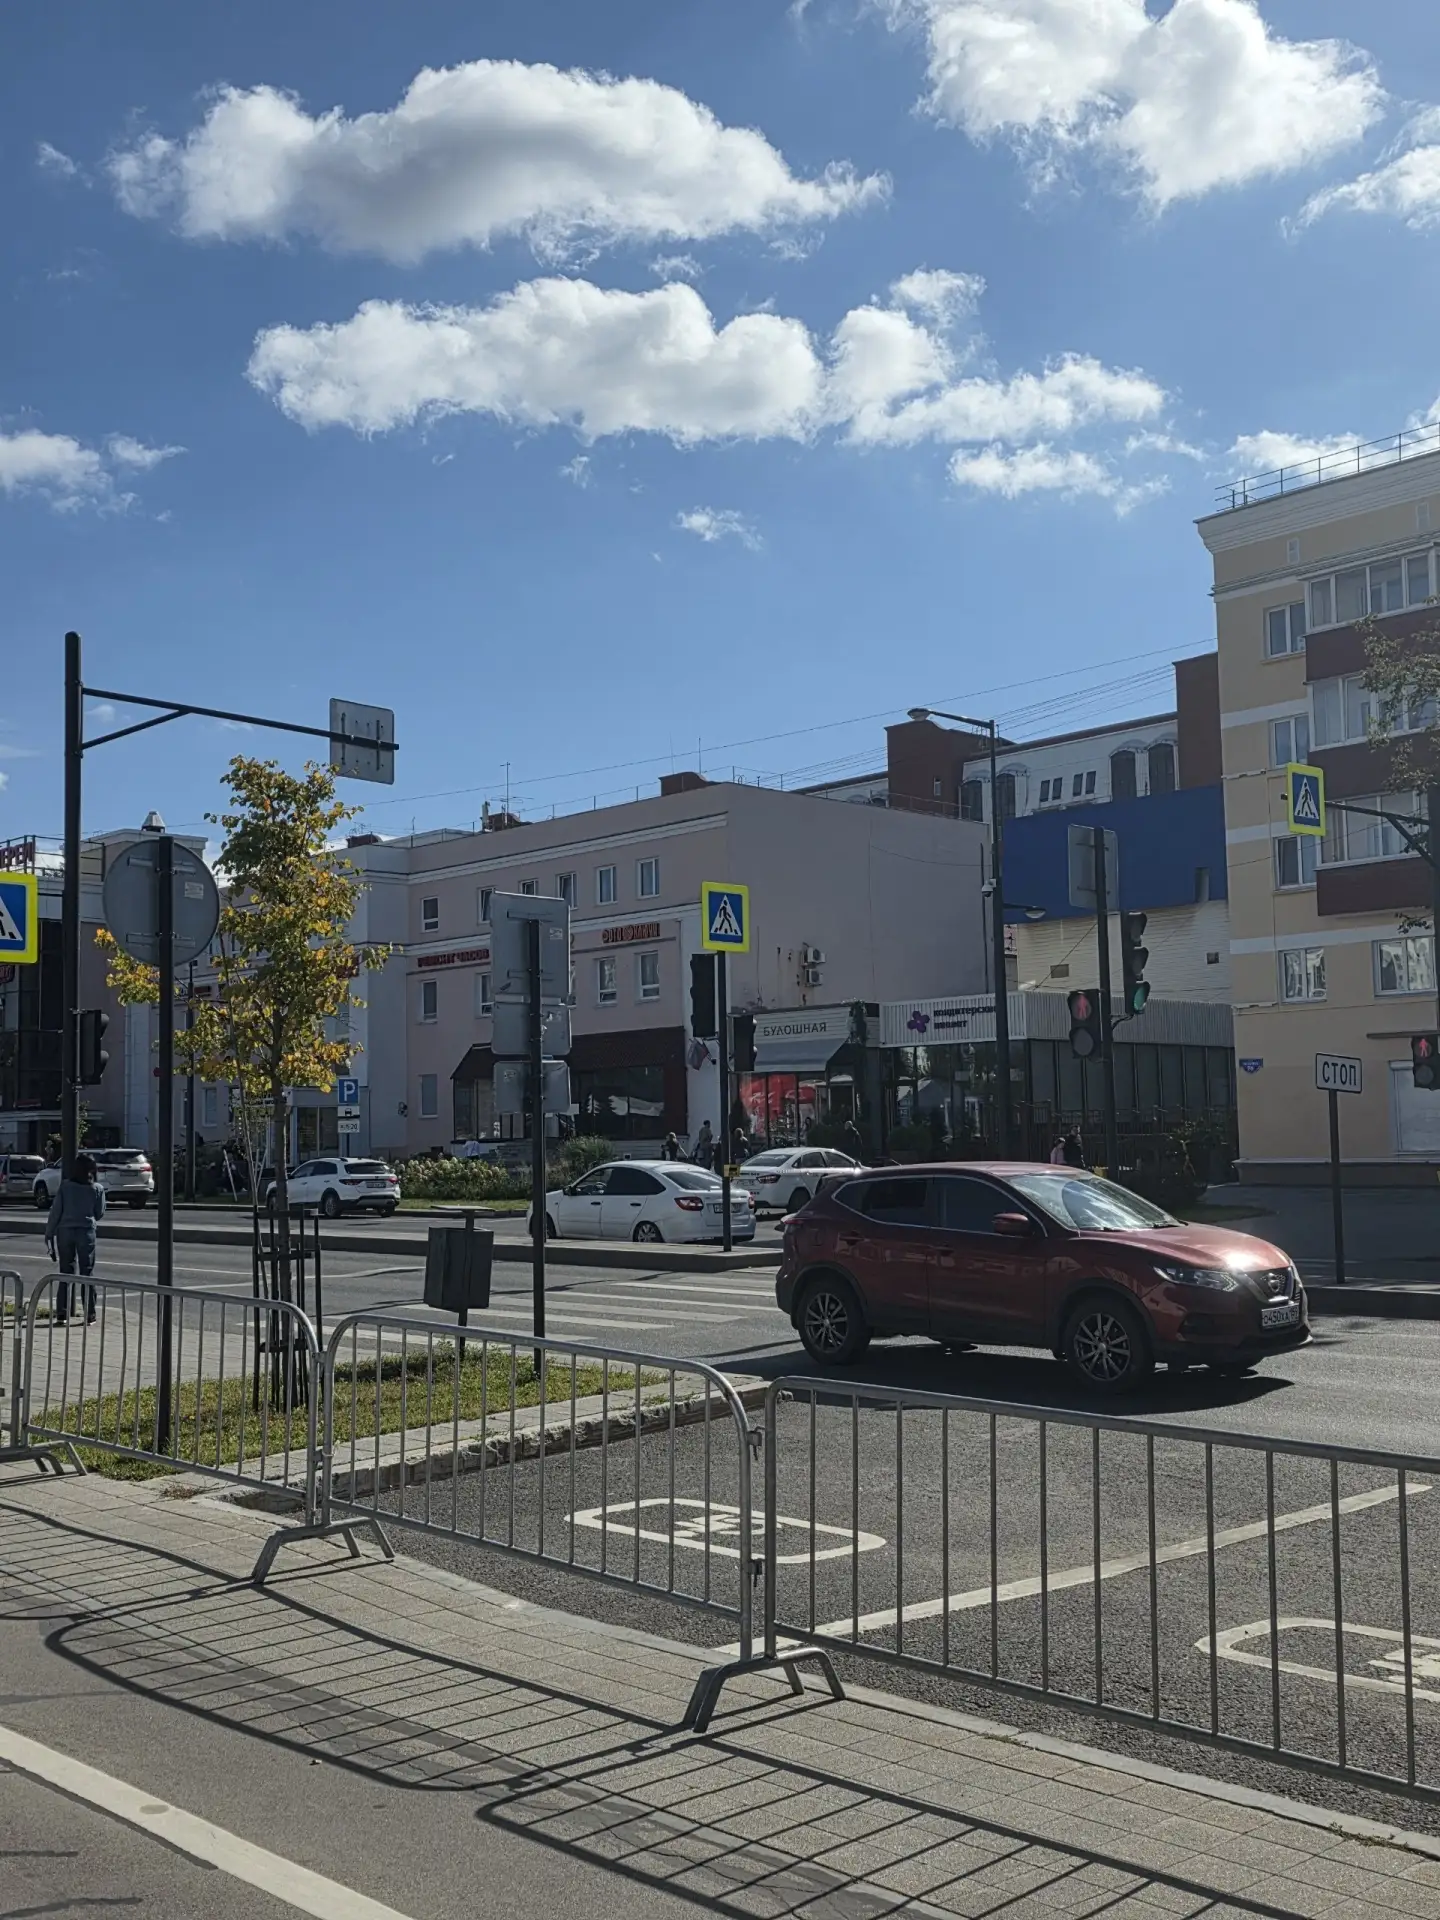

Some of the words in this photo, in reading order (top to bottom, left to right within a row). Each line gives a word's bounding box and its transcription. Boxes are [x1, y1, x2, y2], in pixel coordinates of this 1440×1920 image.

[763, 1022, 827, 1037] БУЛОШНАЯ
[1322, 1060, 1357, 1086] СТОП
[343, 1080, 356, 1102] P
